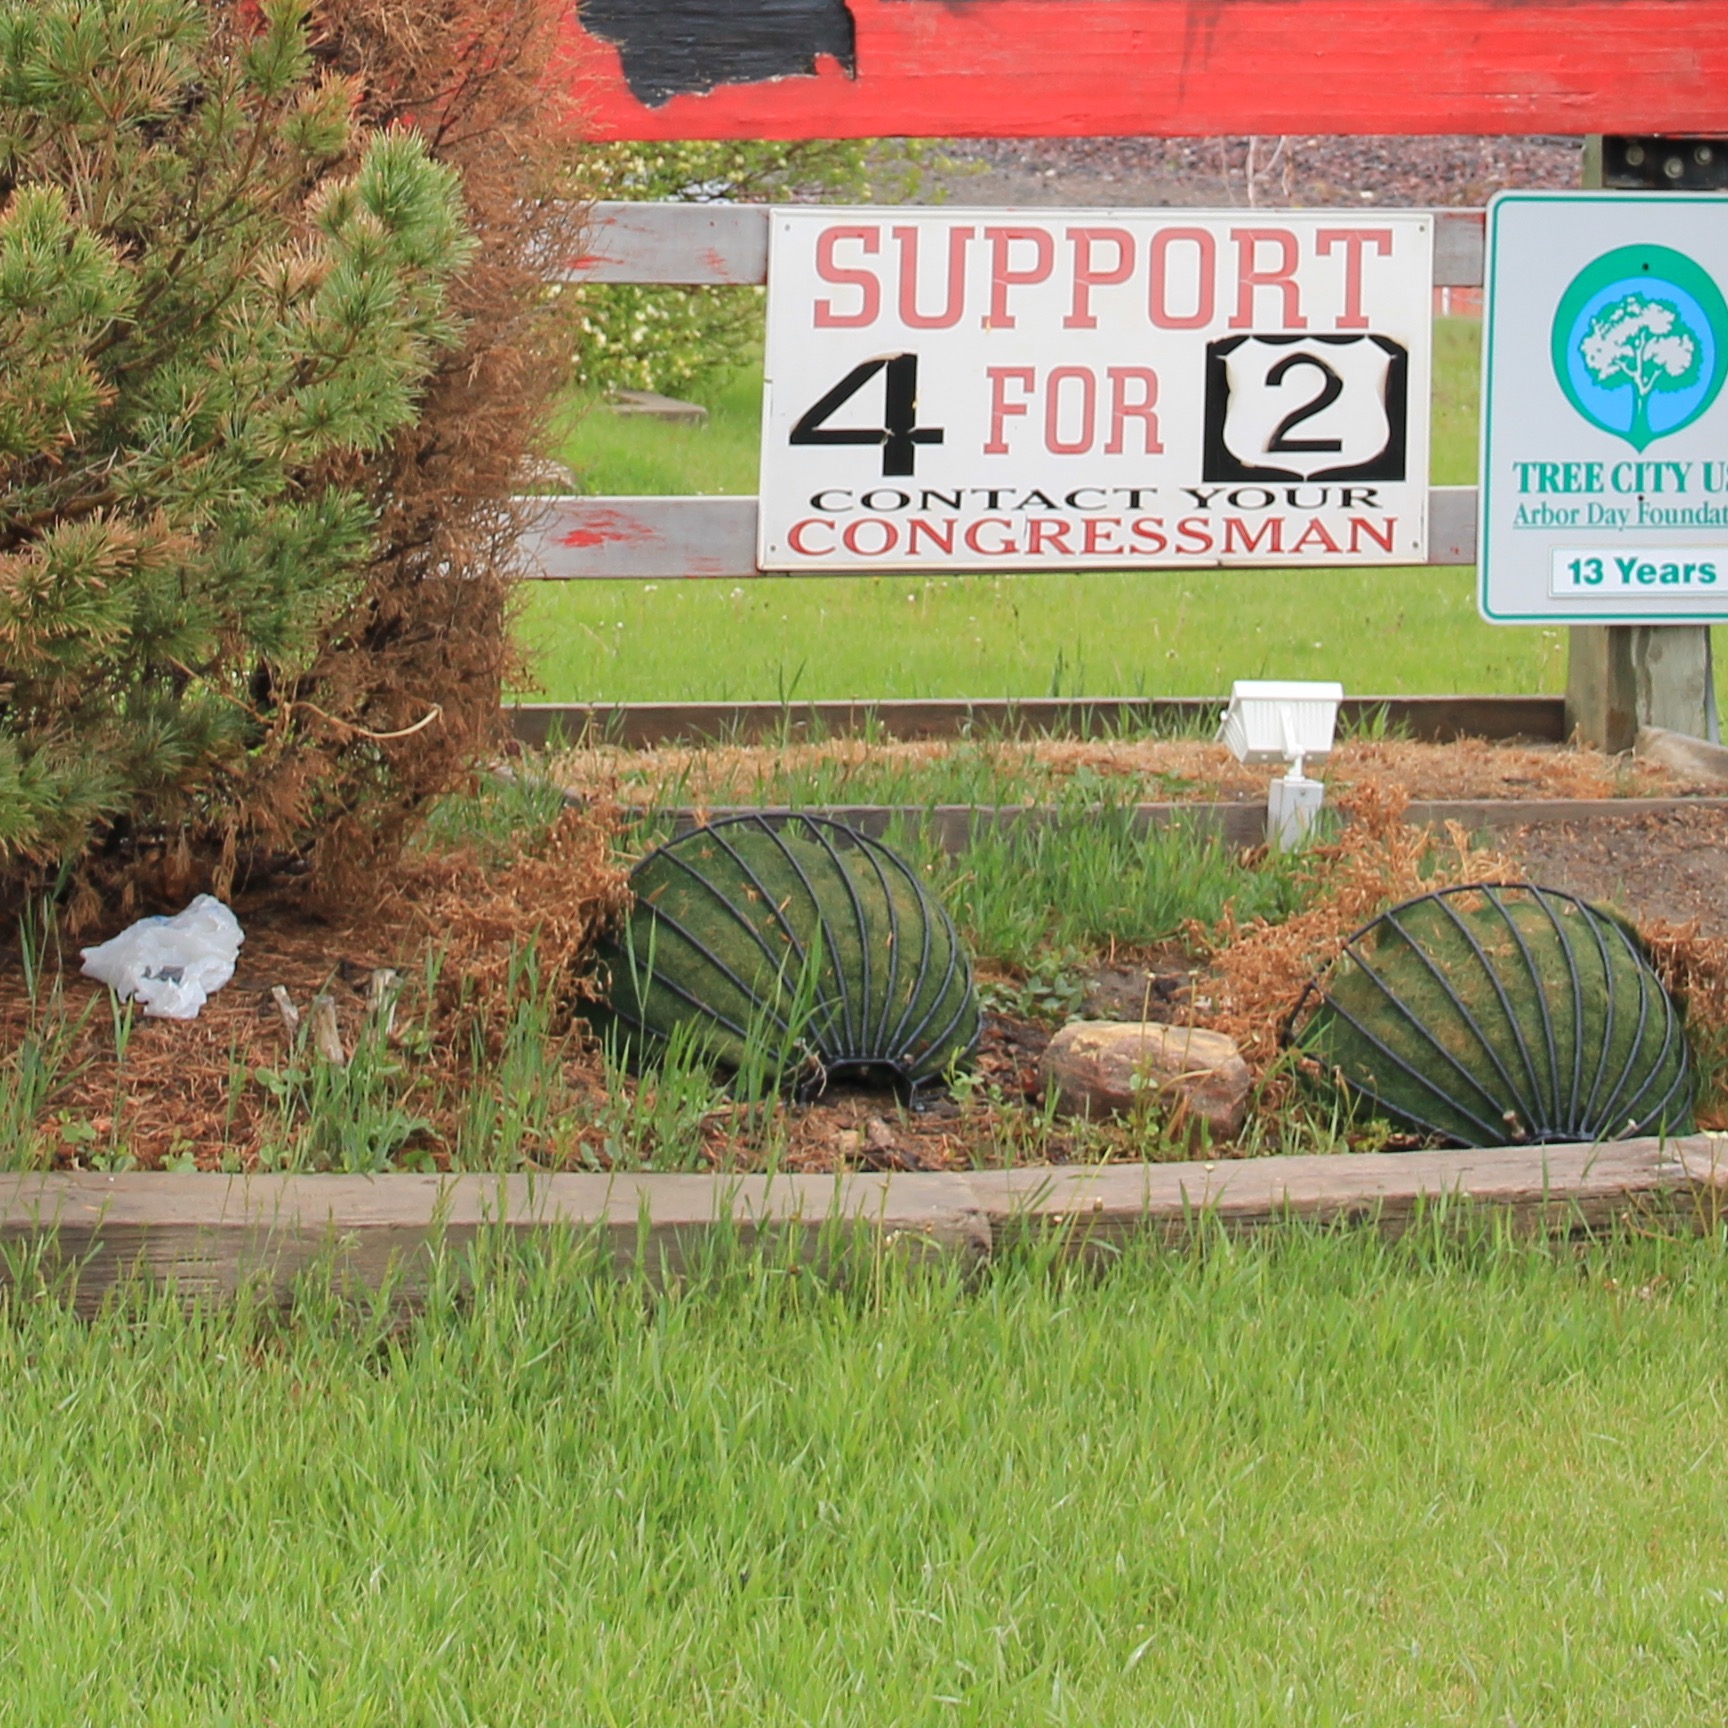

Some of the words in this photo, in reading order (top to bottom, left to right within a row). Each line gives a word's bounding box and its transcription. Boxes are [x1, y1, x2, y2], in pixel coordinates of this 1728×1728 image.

[813, 225, 1393, 330] SUPPORT
[788, 352, 944, 477] 4
[983, 365, 1164, 455] FOR
[1264, 352, 1345, 453] 2
[1512, 460, 1605, 494] TREE
[1610, 460, 1694, 494] CITY
[809, 488, 1157, 512] CONTACT
[1186, 486, 1385, 510] YOUR
[1513, 501, 1580, 526] Arbor
[1586, 501, 1631, 532] Day
[787, 516, 1399, 557] CONGRESSMAN
[1568, 557, 1604, 586] 13
[1613, 557, 1718, 586] Years
